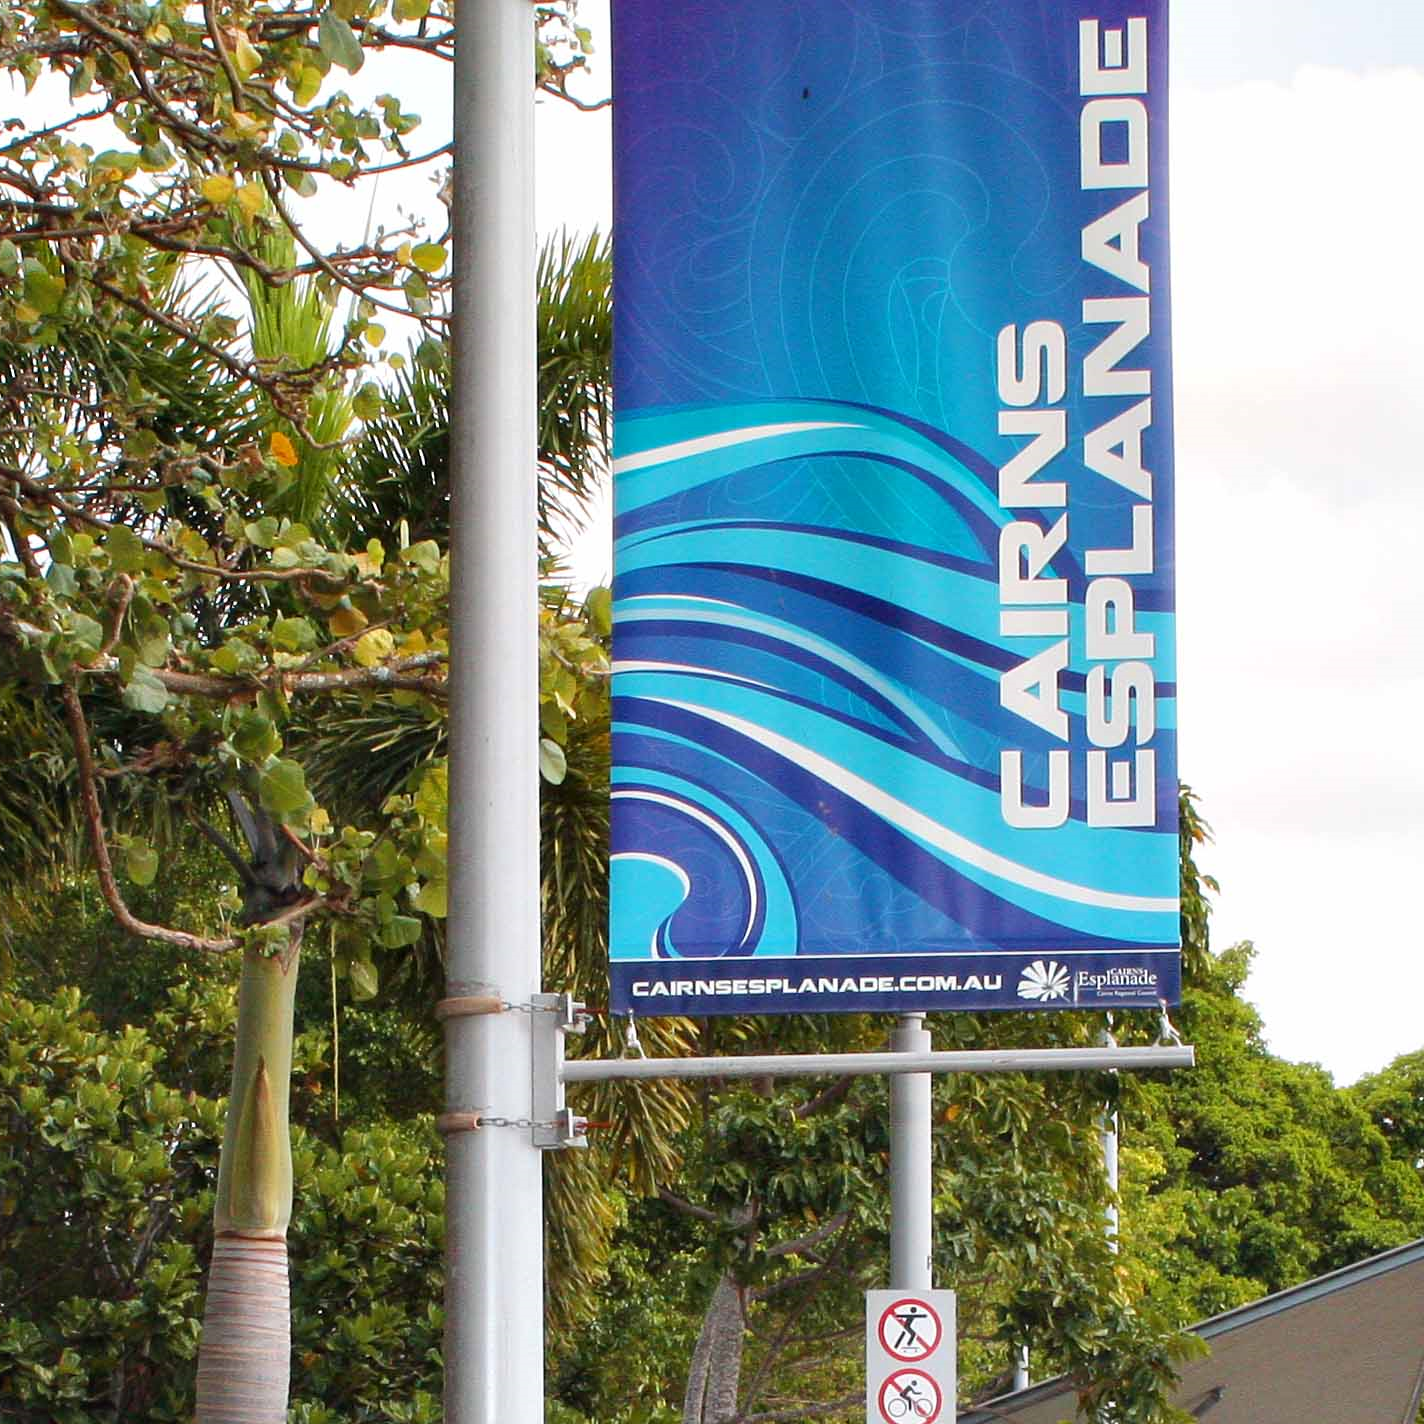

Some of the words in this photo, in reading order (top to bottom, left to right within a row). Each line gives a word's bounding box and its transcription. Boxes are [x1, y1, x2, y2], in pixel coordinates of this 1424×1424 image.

[1079, 16, 1156, 828] ESPLANADE
[997, 319, 1069, 829] CAIRNS
[1079, 969, 1157, 990] Esplanade
[1111, 967, 1144, 975] CAIRNS
[631, 974, 1002, 997] CAIRNSESPLANADE.COM.AU
